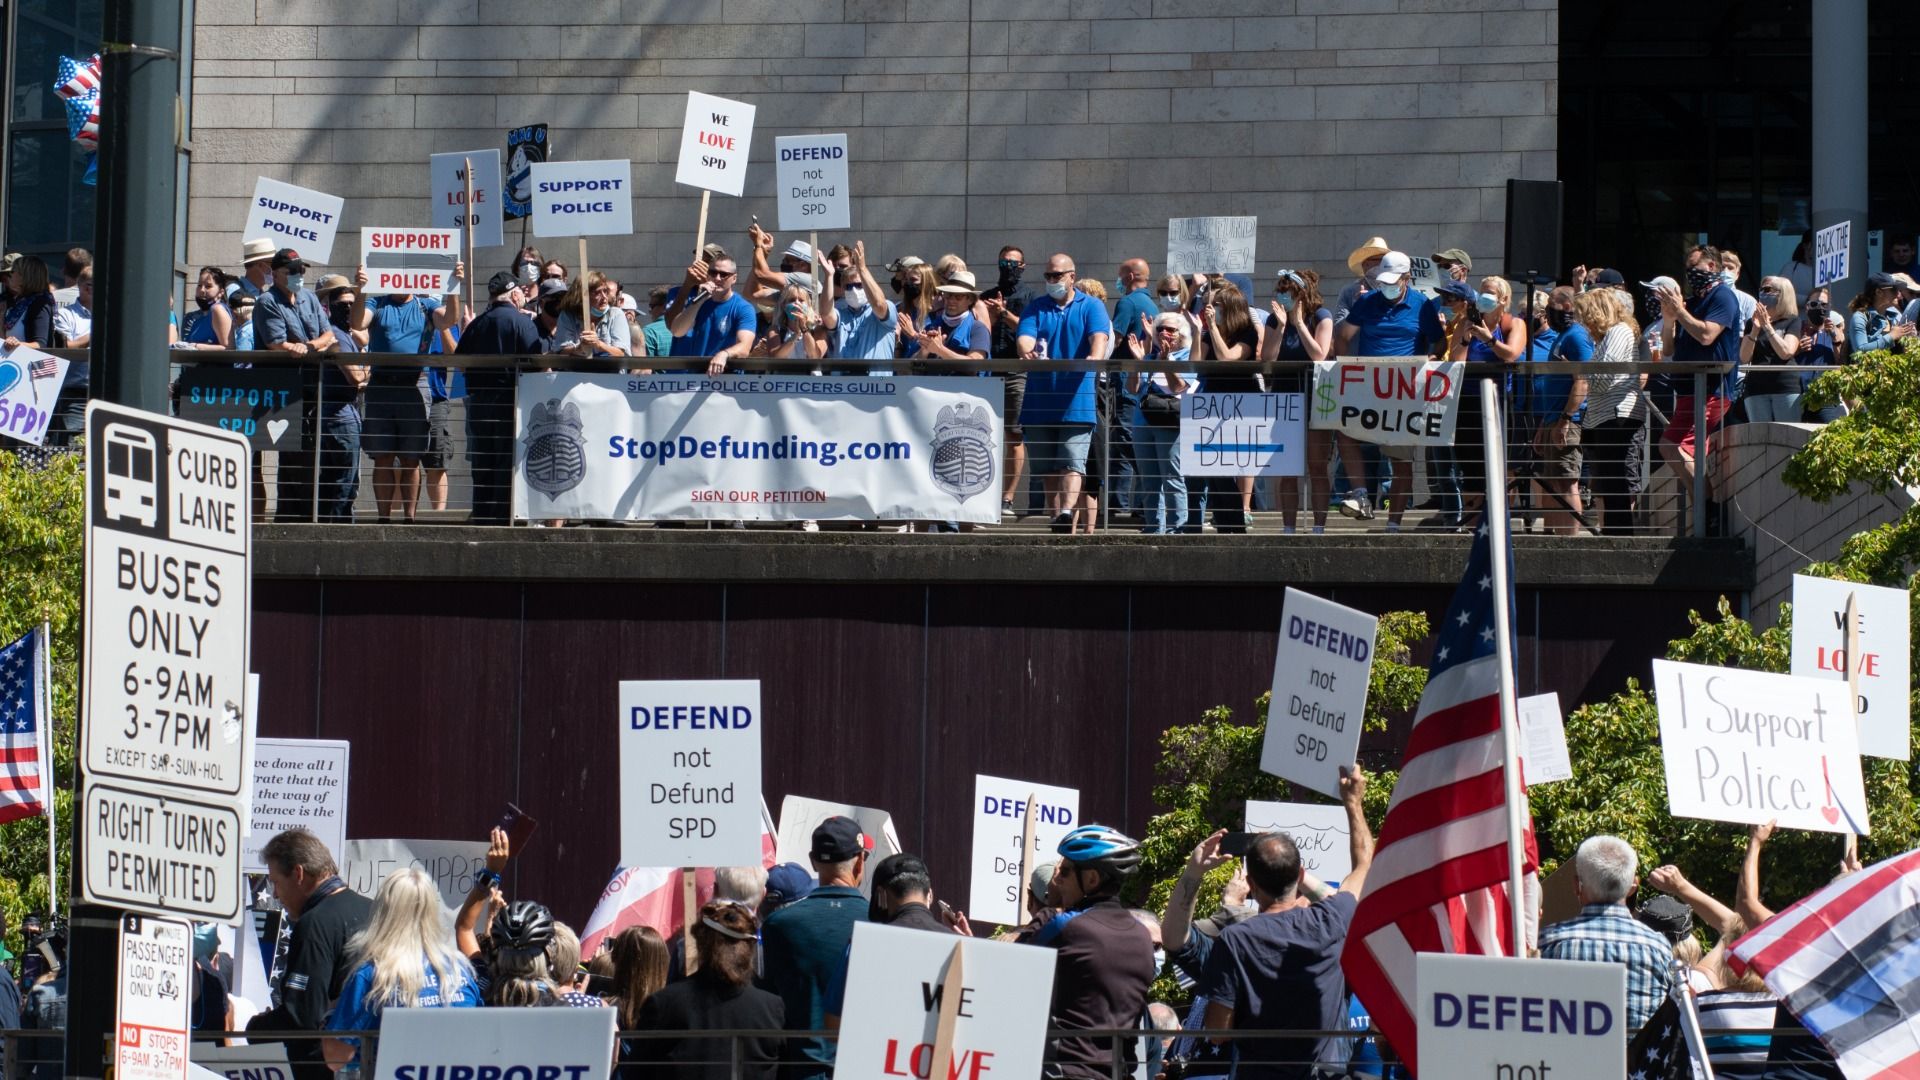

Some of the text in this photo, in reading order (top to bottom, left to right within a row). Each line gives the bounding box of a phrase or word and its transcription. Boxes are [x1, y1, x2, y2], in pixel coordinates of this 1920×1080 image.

[711, 112, 730, 127] WE
[699, 131, 736, 151] LOVE
[701, 155, 727, 170] SPD
[781, 146, 843, 162] DEFEND
[803, 168, 823, 180] not
[539, 179, 623, 193] SUPPORT
[792, 185, 835, 199] Defund
[258, 197, 333, 224] SUPPORT
[551, 202, 613, 214] POLICE
[802, 204, 827, 215] SPD
[262, 219, 318, 242] POLICE
[1171, 218, 1255, 240] FULLY FUND
[371, 233, 451, 249] SUPPORT
[1195, 239, 1228, 252] OUR
[1817, 224, 1848, 258] BACK THE
[1820, 252, 1844, 283] BLUE
[380, 274, 441, 289] POLICE
[627, 380, 896, 394] SEATTLE POLICE OFFICERS GUILD
[1339, 365, 1451, 402] FUND
[191, 386, 290, 408] SUPPORT
[1191, 393, 1299, 422] BACK THE
[1341, 406, 1442, 437] POLICE
[609, 435, 911, 466] StopDefunding.com
[1200, 425, 1270, 468] BLUE
[178, 448, 237, 490] CURB
[691, 490, 826, 503] SIGN OUR PETITION
[179, 493, 236, 534] LANE
[118, 547, 222, 608] BUSES
[129, 605, 210, 659] ONLY
[1288, 615, 1369, 663] DEFEND
[123, 662, 213, 709] 6-9AM
[1310, 667, 1337, 693] not
[631, 705, 752, 730] DEFEND
[1290, 695, 1345, 734] Defund
[1678, 672, 1827, 747] I Support
[123, 704, 211, 751] 3-7PM
[106, 747, 146, 769] EXCEPT
[673, 747, 711, 768] not
[1295, 733, 1328, 762] SPD
[272, 758, 304, 770] done
[307, 760, 324, 771] all
[327, 761, 334, 771] I
[253, 774, 338, 787] rate that the
[258, 789, 330, 804] the way of
[650, 782, 734, 804] Defund
[252, 804, 335, 818] olence is the
[98, 799, 226, 857] RIGHT TURNS
[669, 817, 717, 839] SPD
[1013, 835, 1041, 852] nt
[108, 850, 216, 904] PERMITTED
[130, 918, 137, 931] 3
[126, 940, 185, 967] PASSENGER
[130, 964, 155, 981] LOAD
[130, 982, 154, 998] ONLY
[1433, 992, 1613, 1036] DEFEND
[122, 1026, 178, 1051] NO STOPS
[122, 1050, 183, 1070] 6-9AM 3-7PM
[1496, 1060, 1552, 1080] not
